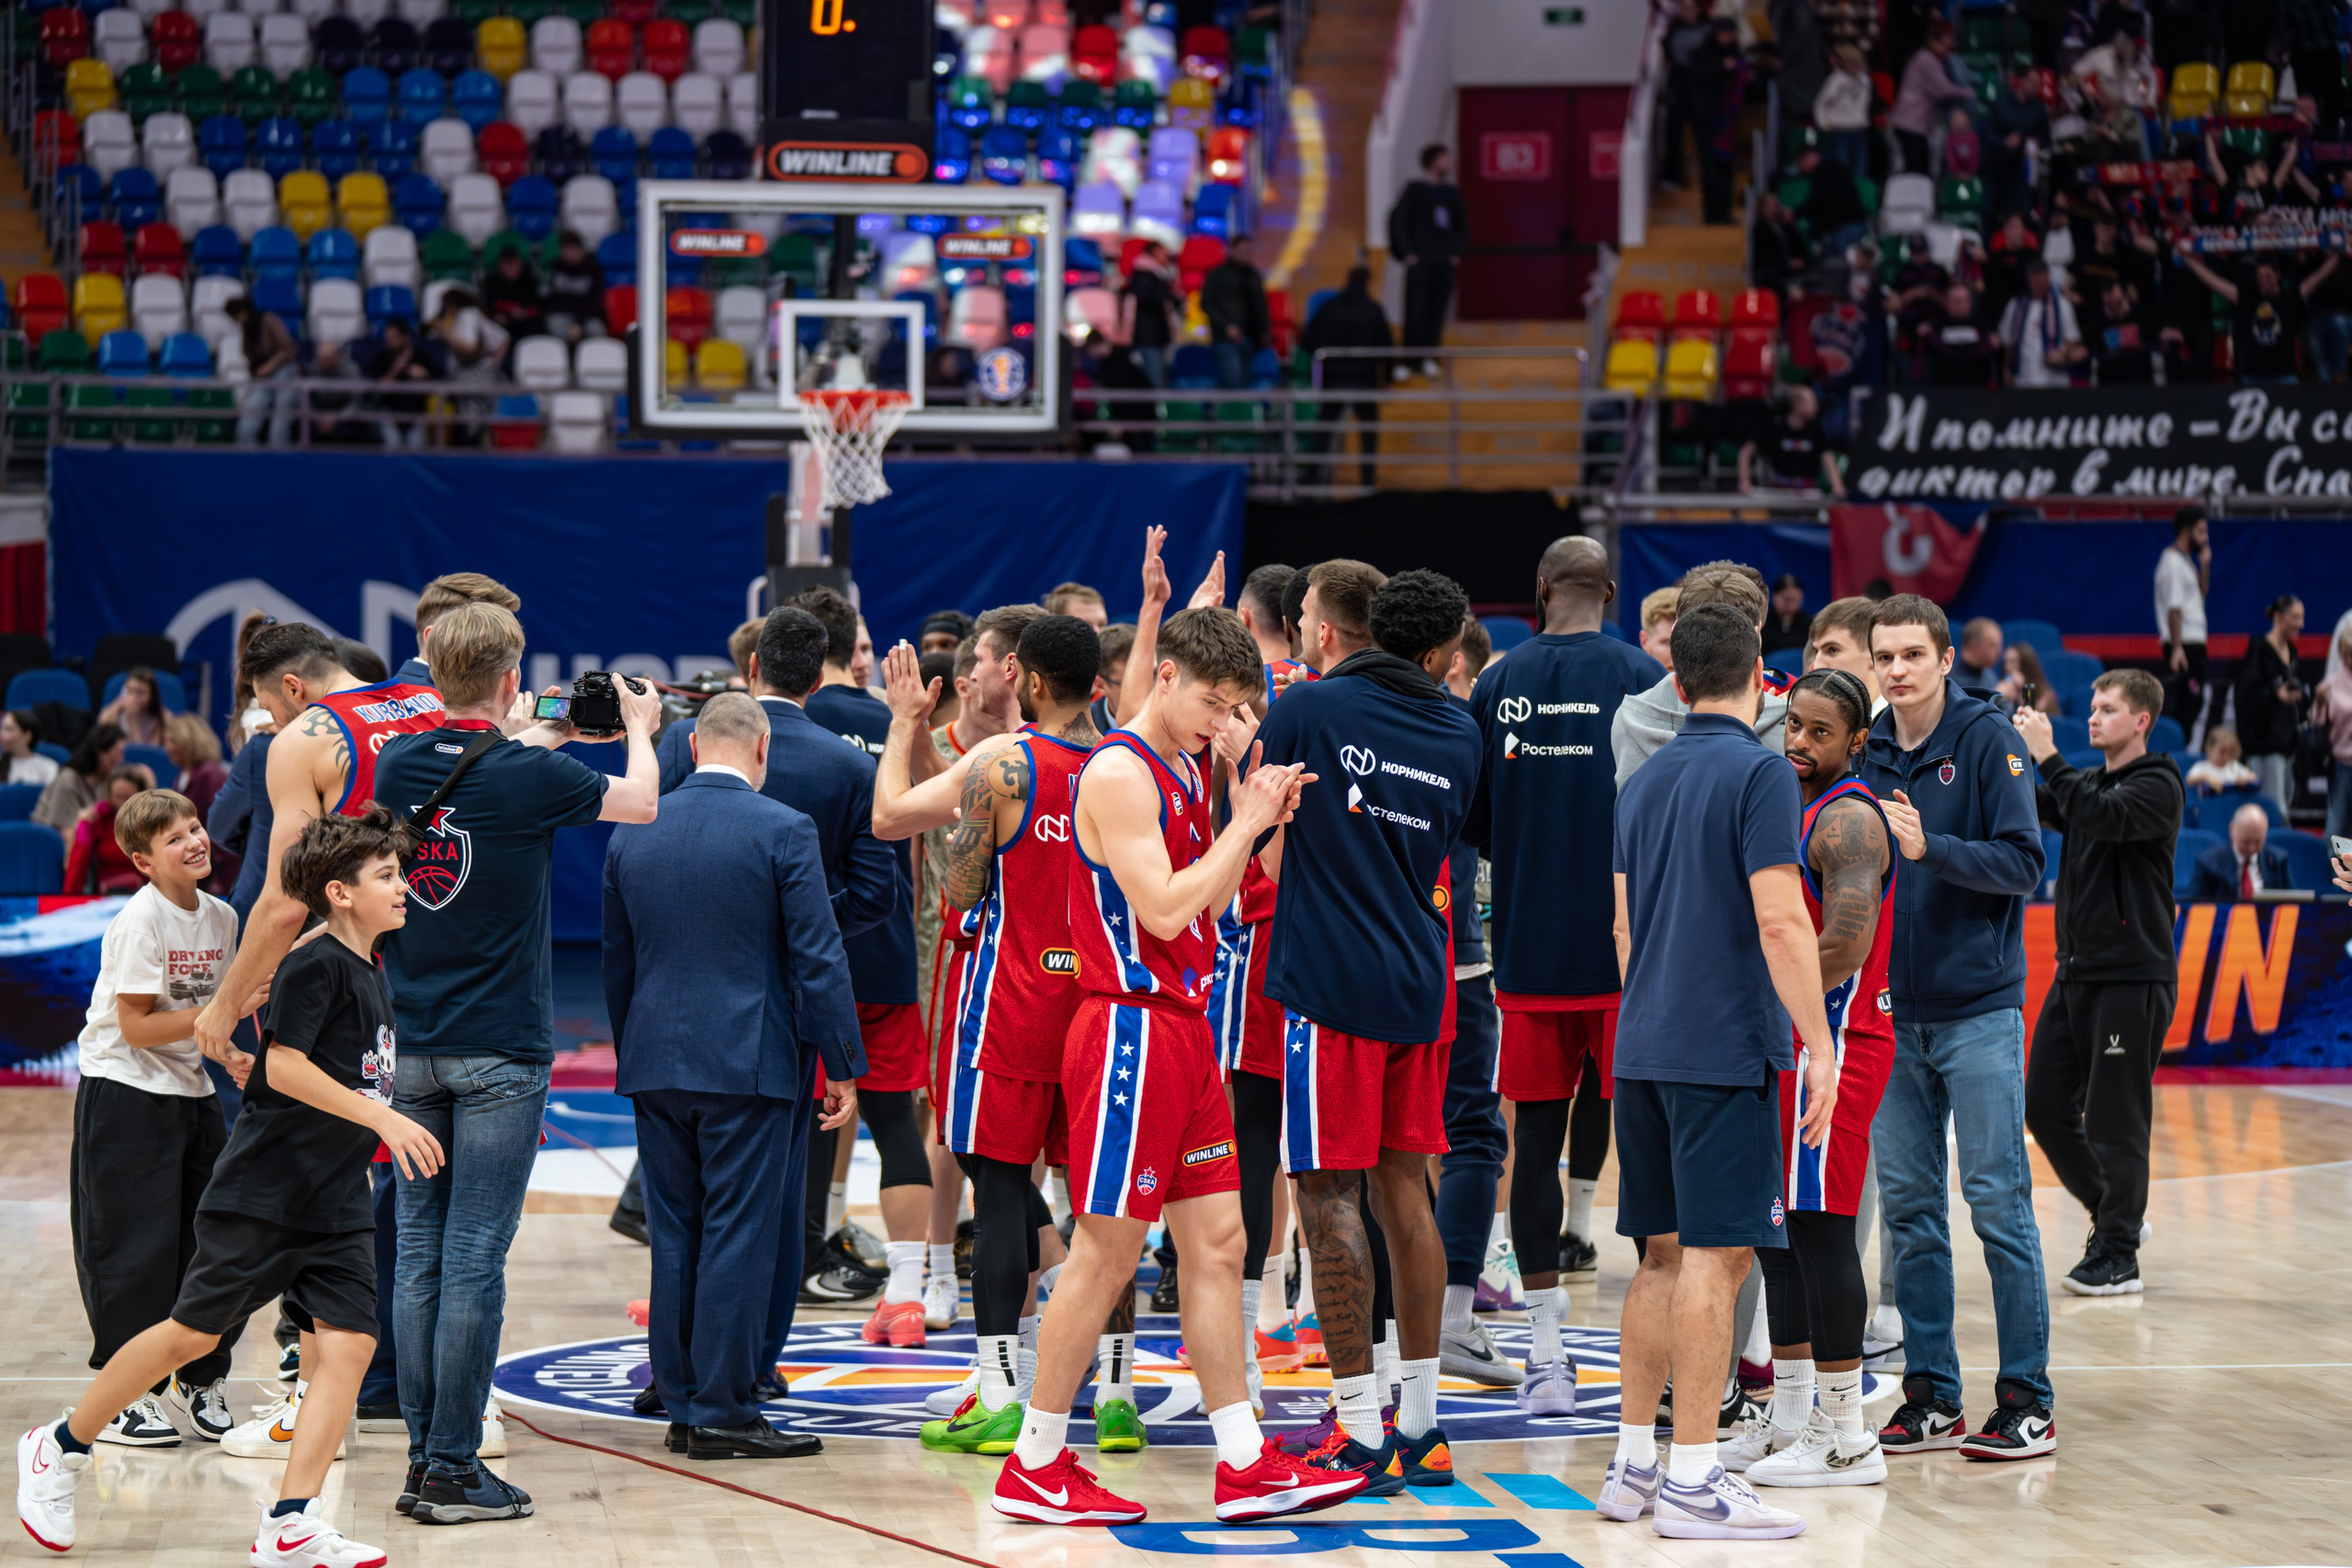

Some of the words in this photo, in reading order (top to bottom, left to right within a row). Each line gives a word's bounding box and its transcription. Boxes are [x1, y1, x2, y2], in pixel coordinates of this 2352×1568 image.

[781, 148, 894, 176] WINLINE
[677, 233, 746, 251] WINLINE
[944, 237, 1012, 254] WINLINE
[1877, 392, 1928, 453] И
[1930, 412, 2174, 451] помните
[1537, 702, 1600, 715] НОРНИКЕЛЬ
[1381, 761, 1452, 790] НОРНИКЕЛЬ
[1366, 804, 1431, 831] стелеком
[416, 841, 459, 861] SKA
[1186, 1144, 1229, 1164] WINLINE
[1139, 1176, 1156, 1186] CSKA
[1839, 1393, 1846, 1402] 2
[1031, 1427, 1037, 1435] 9
